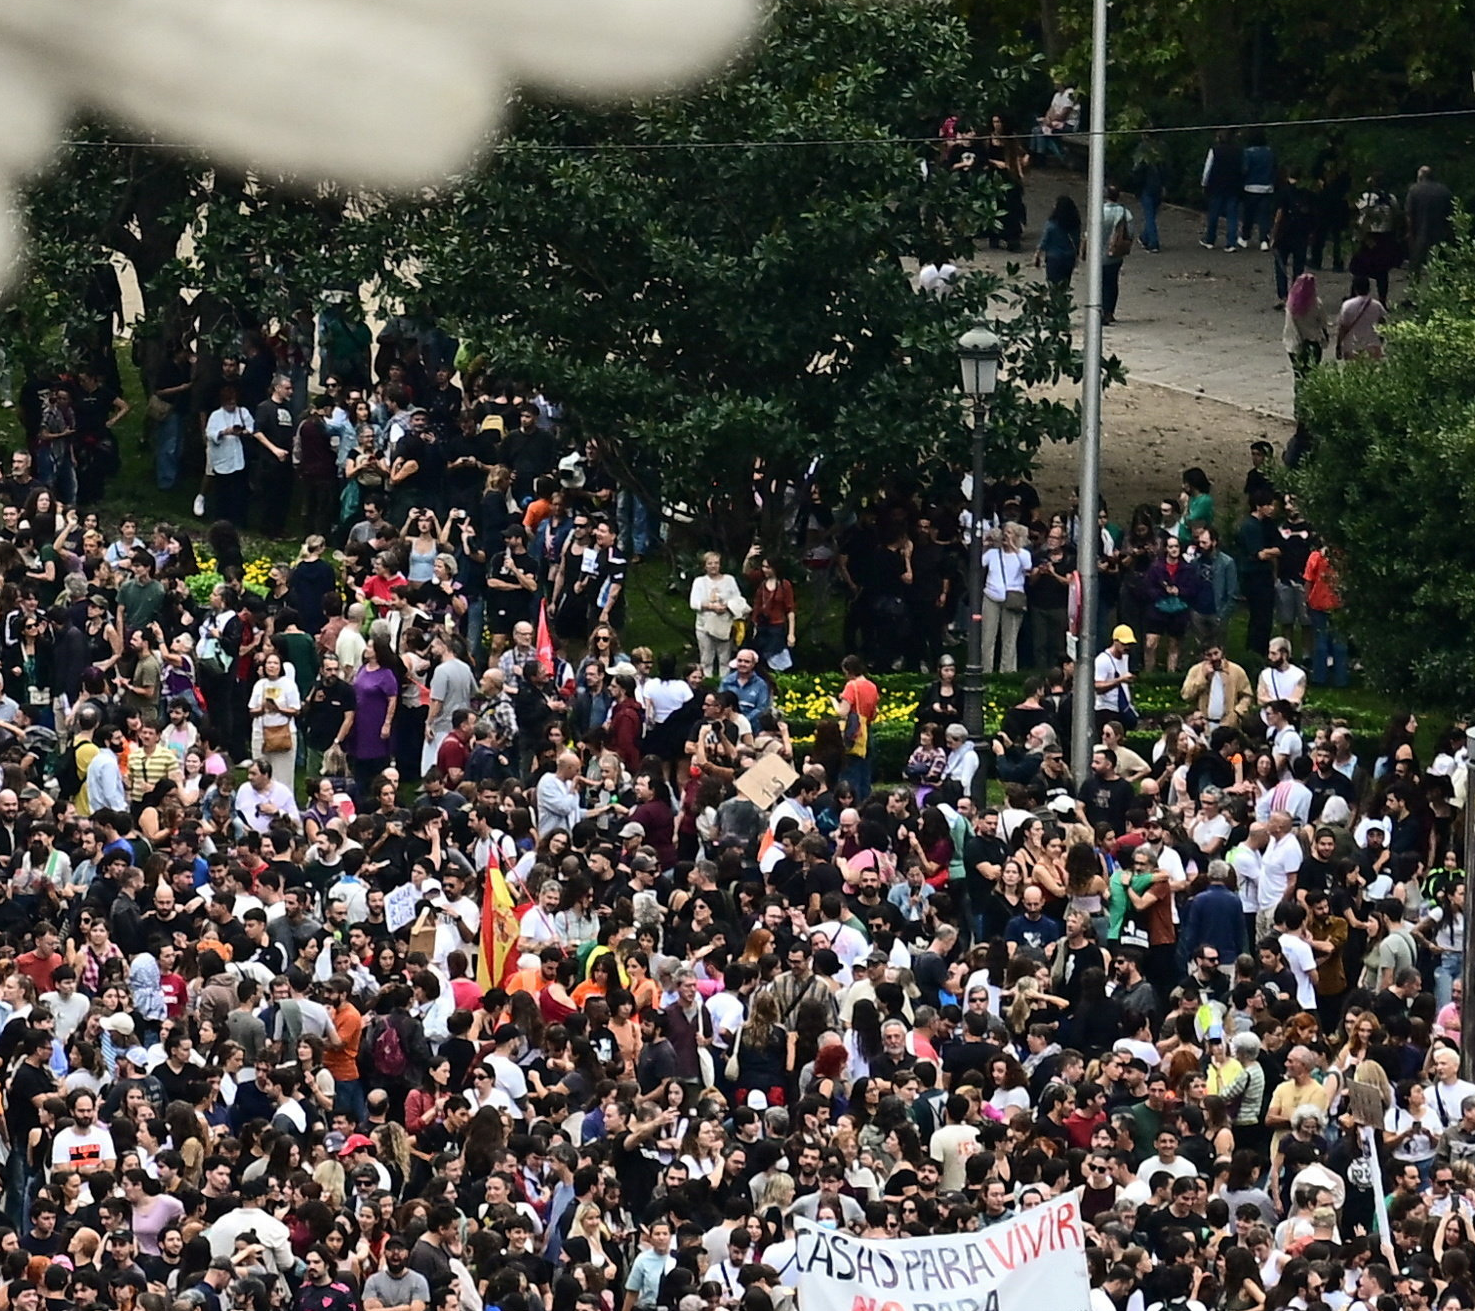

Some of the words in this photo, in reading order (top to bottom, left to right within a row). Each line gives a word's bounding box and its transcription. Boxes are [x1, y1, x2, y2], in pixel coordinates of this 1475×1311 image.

[796, 1226, 898, 1289] CASAS
[903, 1243, 995, 1291] PARA
[986, 1202, 1081, 1270] VIVIR
